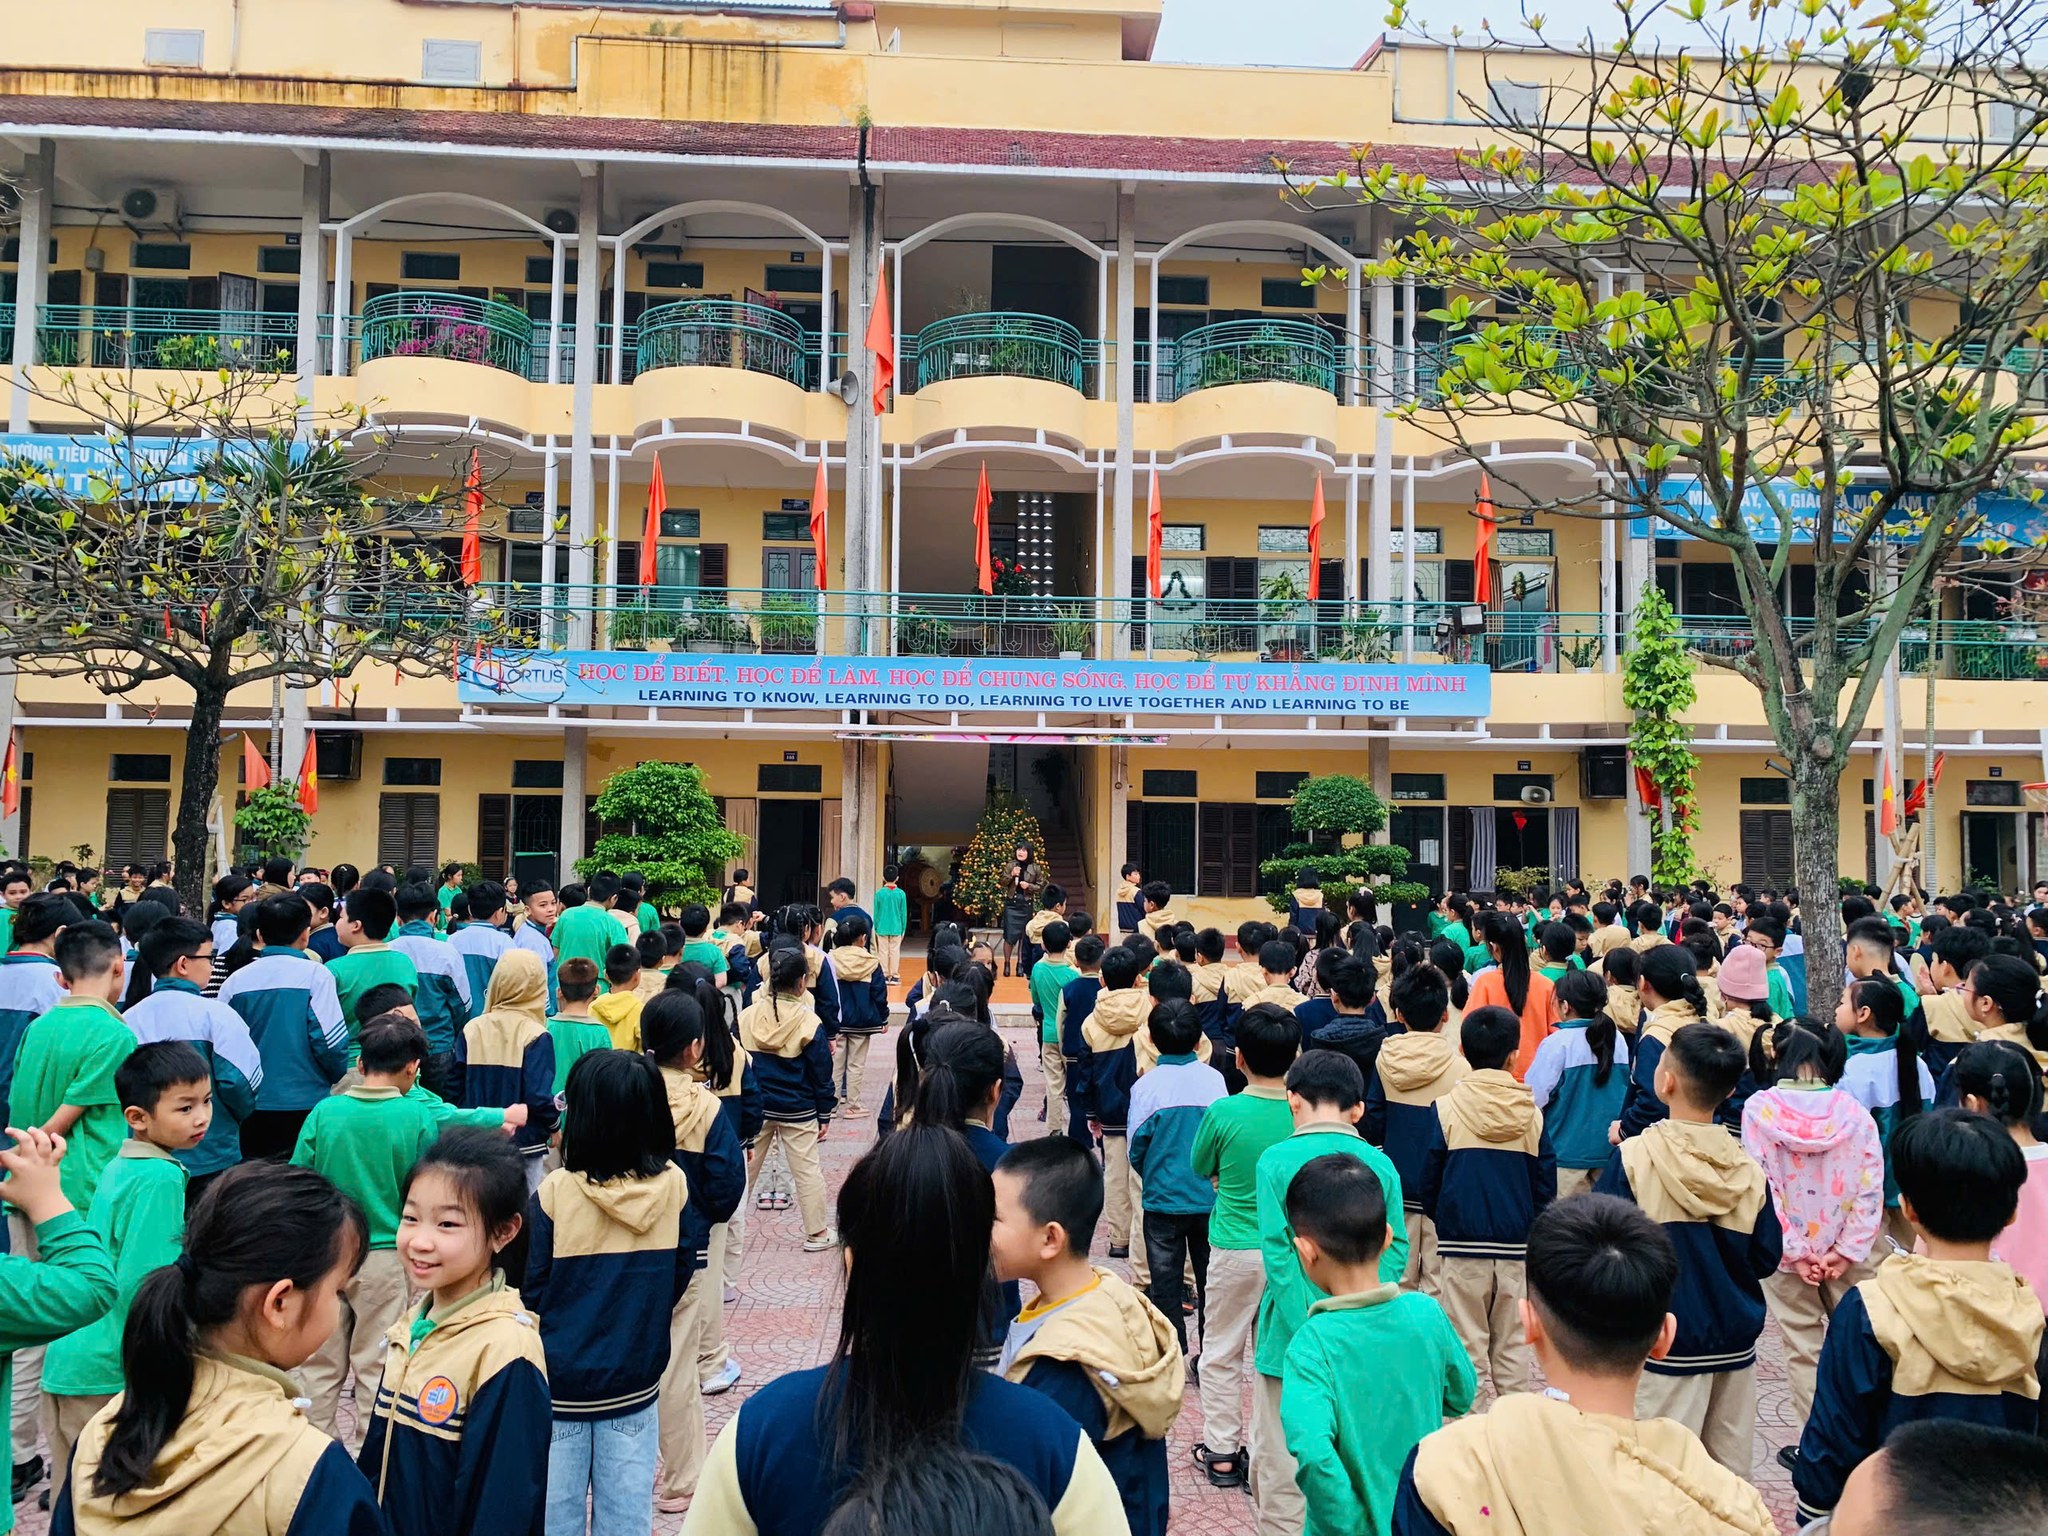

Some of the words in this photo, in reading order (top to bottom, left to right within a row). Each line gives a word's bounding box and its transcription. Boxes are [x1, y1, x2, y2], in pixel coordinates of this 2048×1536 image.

[507, 668, 564, 684] ORTUS
[578, 663, 626, 684] HỌC
[633, 655, 665, 682] ĐỂ
[672, 658, 729, 685] BIẾT,
[737, 667, 784, 688] HỌC
[791, 657, 823, 685] ĐỂ
[829, 663, 881, 688] LÀM,
[888, 669, 935, 690] HỌC
[942, 660, 973, 687] ĐỂ
[978, 670, 1056, 688] CHUNG
[1063, 665, 1128, 691] SỐNG,
[1134, 672, 1180, 693] HỌC
[1186, 664, 1216, 690] ĐỂ
[1222, 672, 1252, 695] TỰ
[1255, 664, 1337, 691] KHẲNG
[1343, 675, 1400, 696] ĐỊNH
[1406, 671, 1467, 692] MÌNH
[638, 689, 728, 703] LEARNING
[733, 691, 756, 703] TO
[762, 691, 820, 706] KNOW,
[825, 692, 911, 705] LEARNING
[917, 694, 939, 705] TO
[945, 694, 975, 708] DO,
[980, 695, 1065, 706] LEARNING
[1070, 696, 1092, 707] TO
[1098, 696, 1133, 708] LIVE
[1138, 697, 1226, 709] TOGETHER
[1231, 698, 1267, 709] AND
[1273, 698, 1356, 710] LEARNING
[1362, 699, 1384, 710] TO
[1389, 699, 1410, 711] BE
